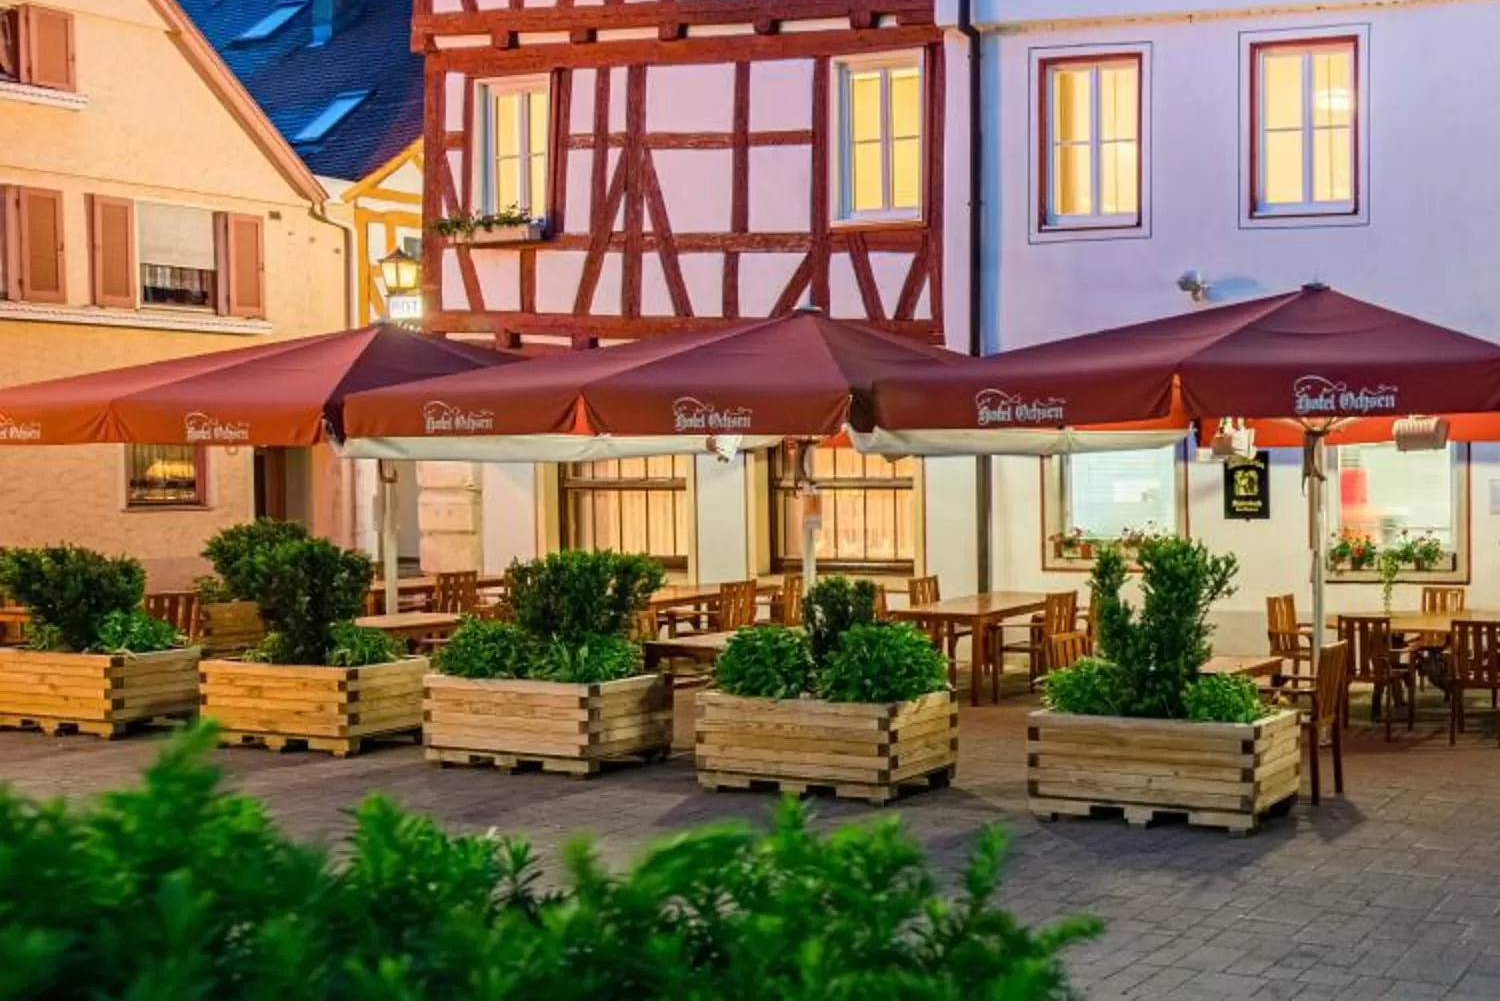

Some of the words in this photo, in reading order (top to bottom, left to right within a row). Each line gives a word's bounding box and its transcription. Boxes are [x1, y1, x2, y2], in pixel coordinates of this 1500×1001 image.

[976, 398, 1013, 426] Hotel
[1015, 400, 1064, 423] Ochsen
[1294, 387, 1336, 415] Hotel
[1339, 387, 1396, 414] Ochsen
